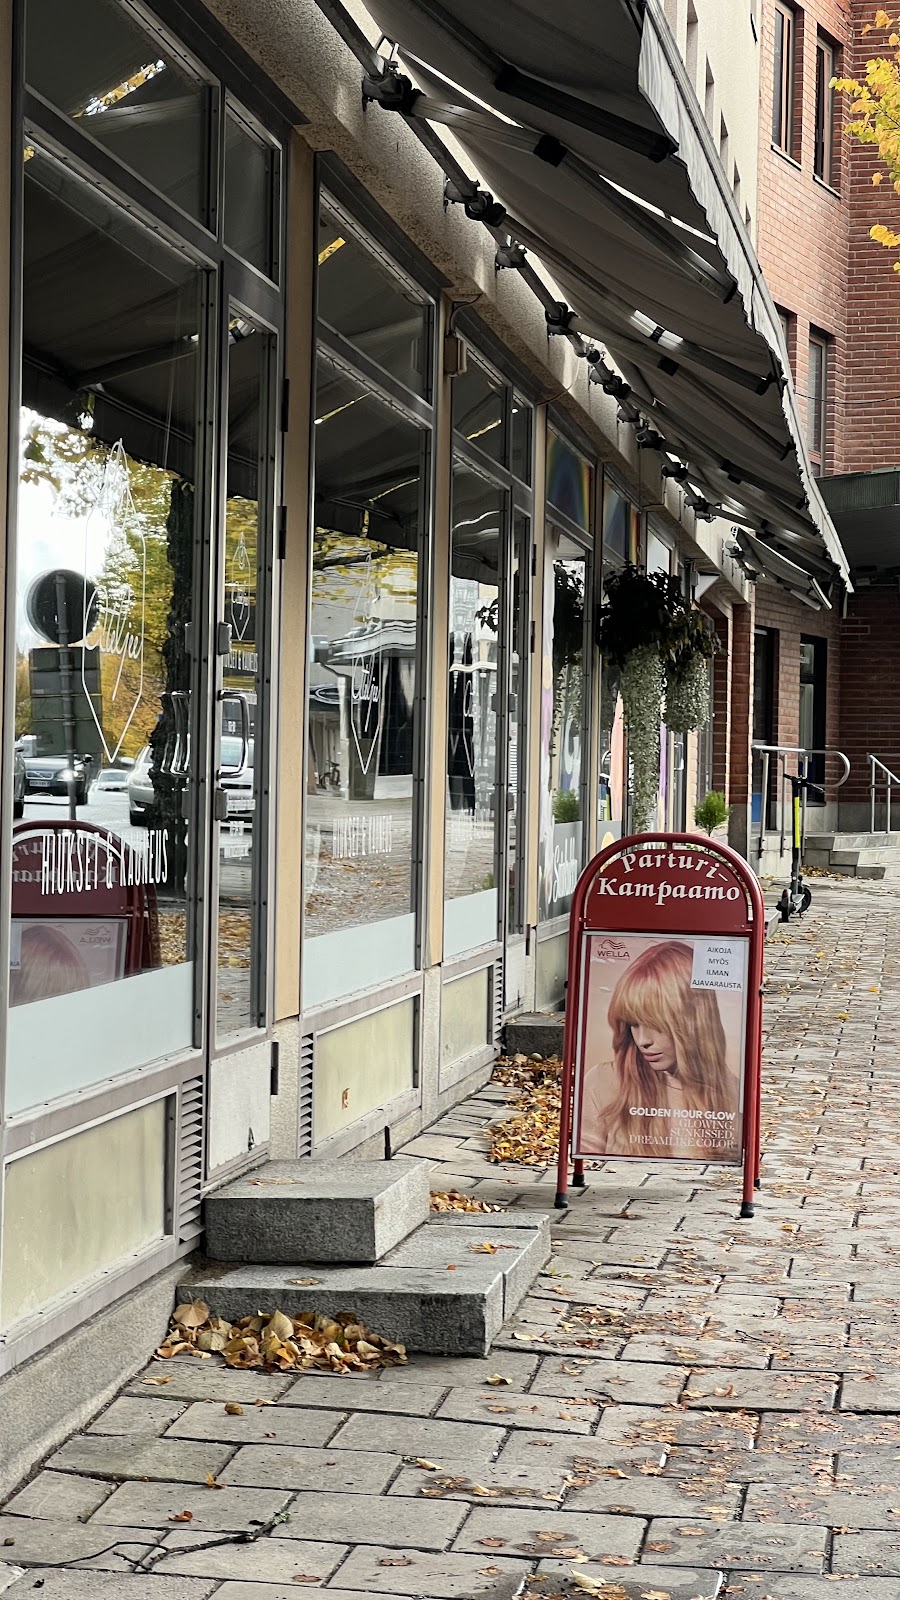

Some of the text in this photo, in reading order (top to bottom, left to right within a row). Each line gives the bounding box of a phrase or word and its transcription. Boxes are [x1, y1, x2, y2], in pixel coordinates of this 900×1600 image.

[41, 832, 100, 895] HIUKSET
[106, 831, 114, 889] &
[620, 851, 728, 882] Parturi-
[597, 877, 740, 906] Kampaamo
[597, 950, 630, 958] WELLA
[707, 946, 732, 955] AIKOJA
[708, 957, 729, 966] MYÖS
[706, 969, 729, 977] ILMAN
[692, 979, 742, 989] AJAVARAUSTA
[629, 1107, 736, 1121] GOLDEN HOUR GLOW
[629, 1135, 734, 1149] DREAMLIKE COLOR
